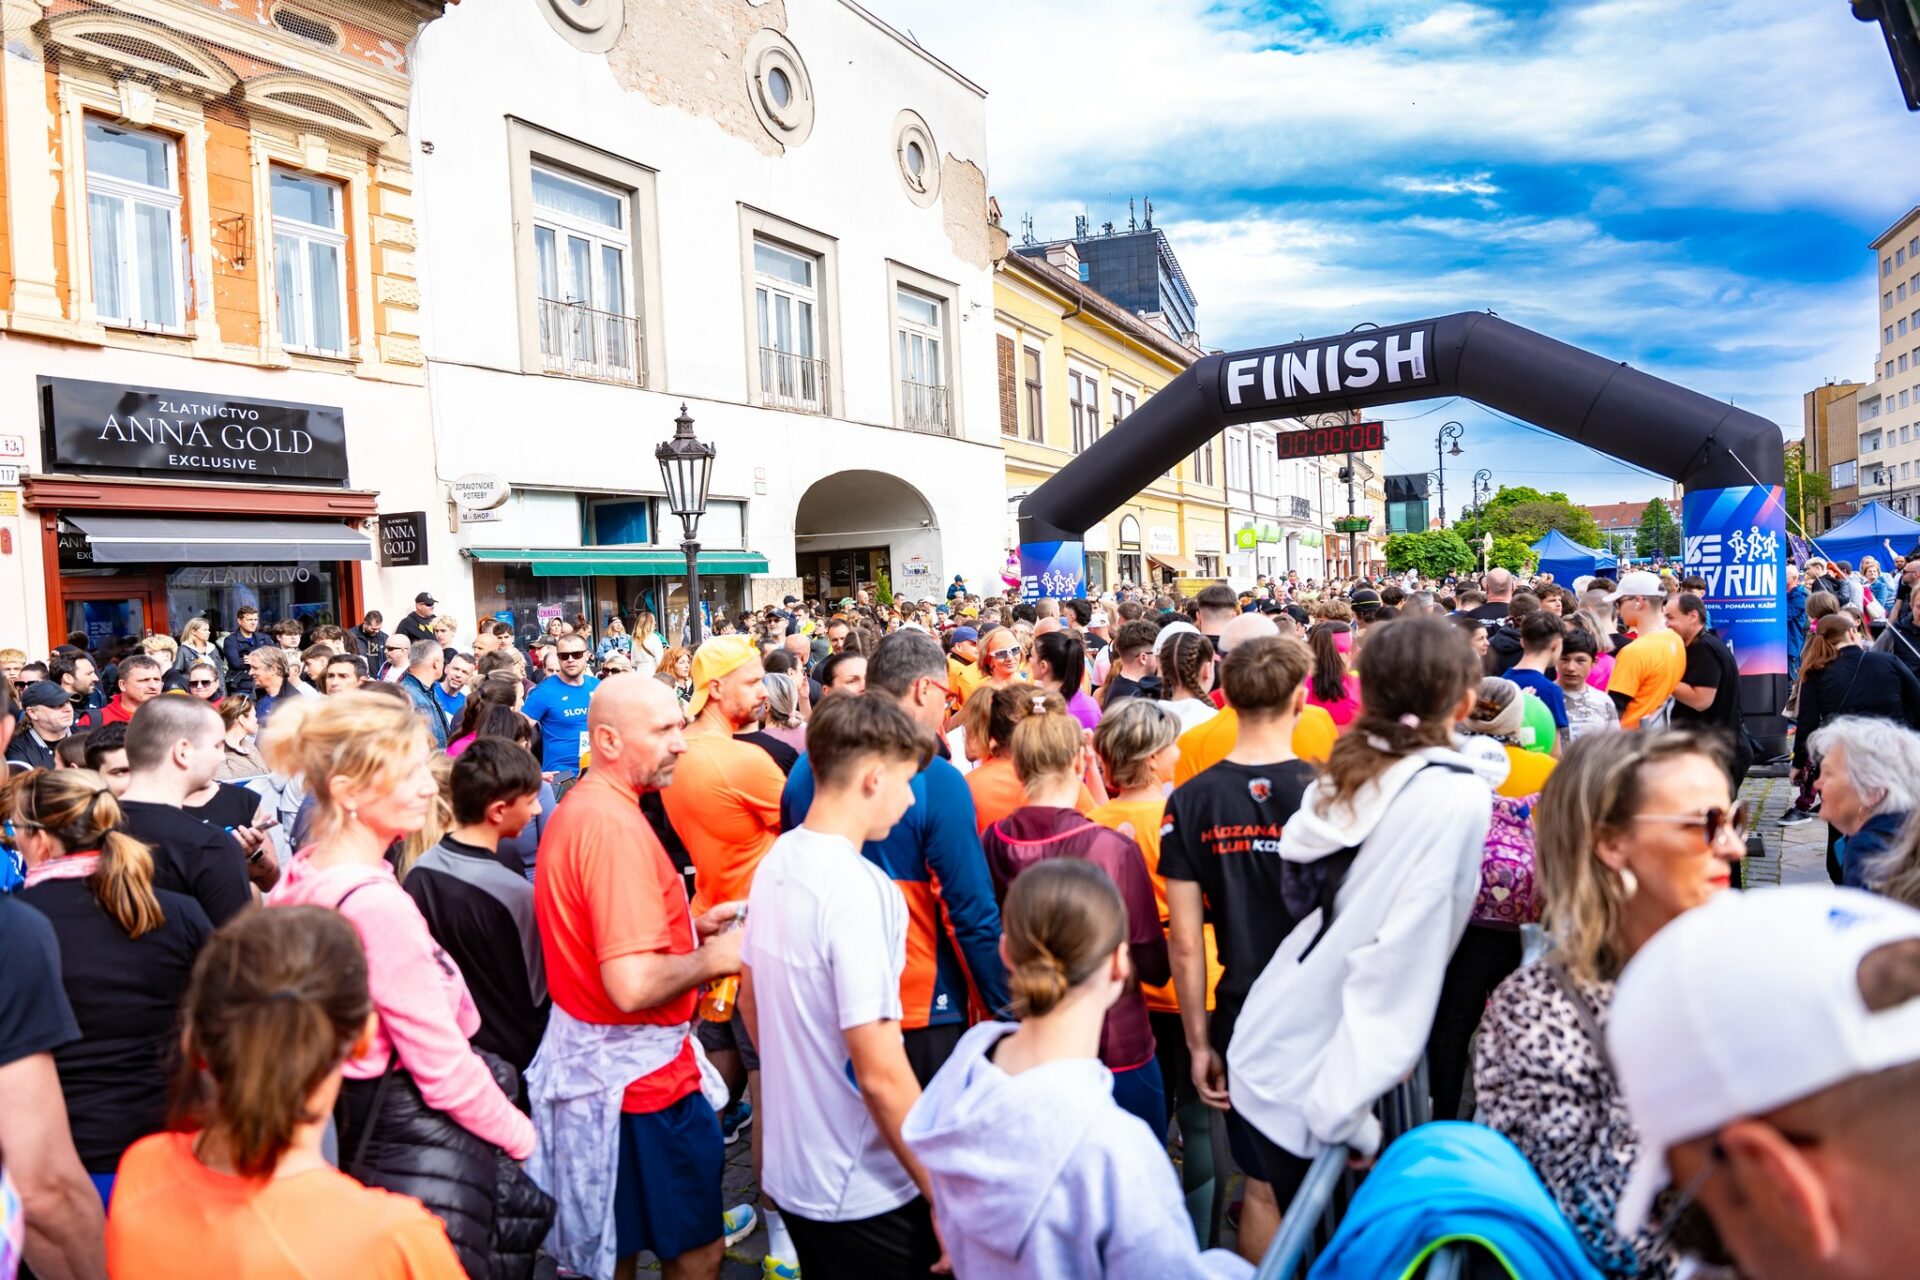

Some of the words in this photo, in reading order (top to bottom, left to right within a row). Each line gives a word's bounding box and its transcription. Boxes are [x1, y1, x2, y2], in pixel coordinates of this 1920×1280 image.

[1227, 331, 1427, 405] FINISH
[158, 401, 259, 420] ZLATNÍCTVO
[97, 413, 213, 448] ANNA
[221, 424, 313, 454] GOLD
[1279, 423, 1381, 458] 00:00:00
[168, 454, 257, 470] EXCLUSIVE
[463, 491, 488, 500] POTREBY
[382, 525, 416, 540] ANNA
[59, 536, 93, 548] ANN
[383, 540, 416, 555] GOLD
[201, 565, 310, 584] ZLATNÍCTVO
[1724, 563, 1777, 597] RUN
[563, 707, 589, 717] SLOV
